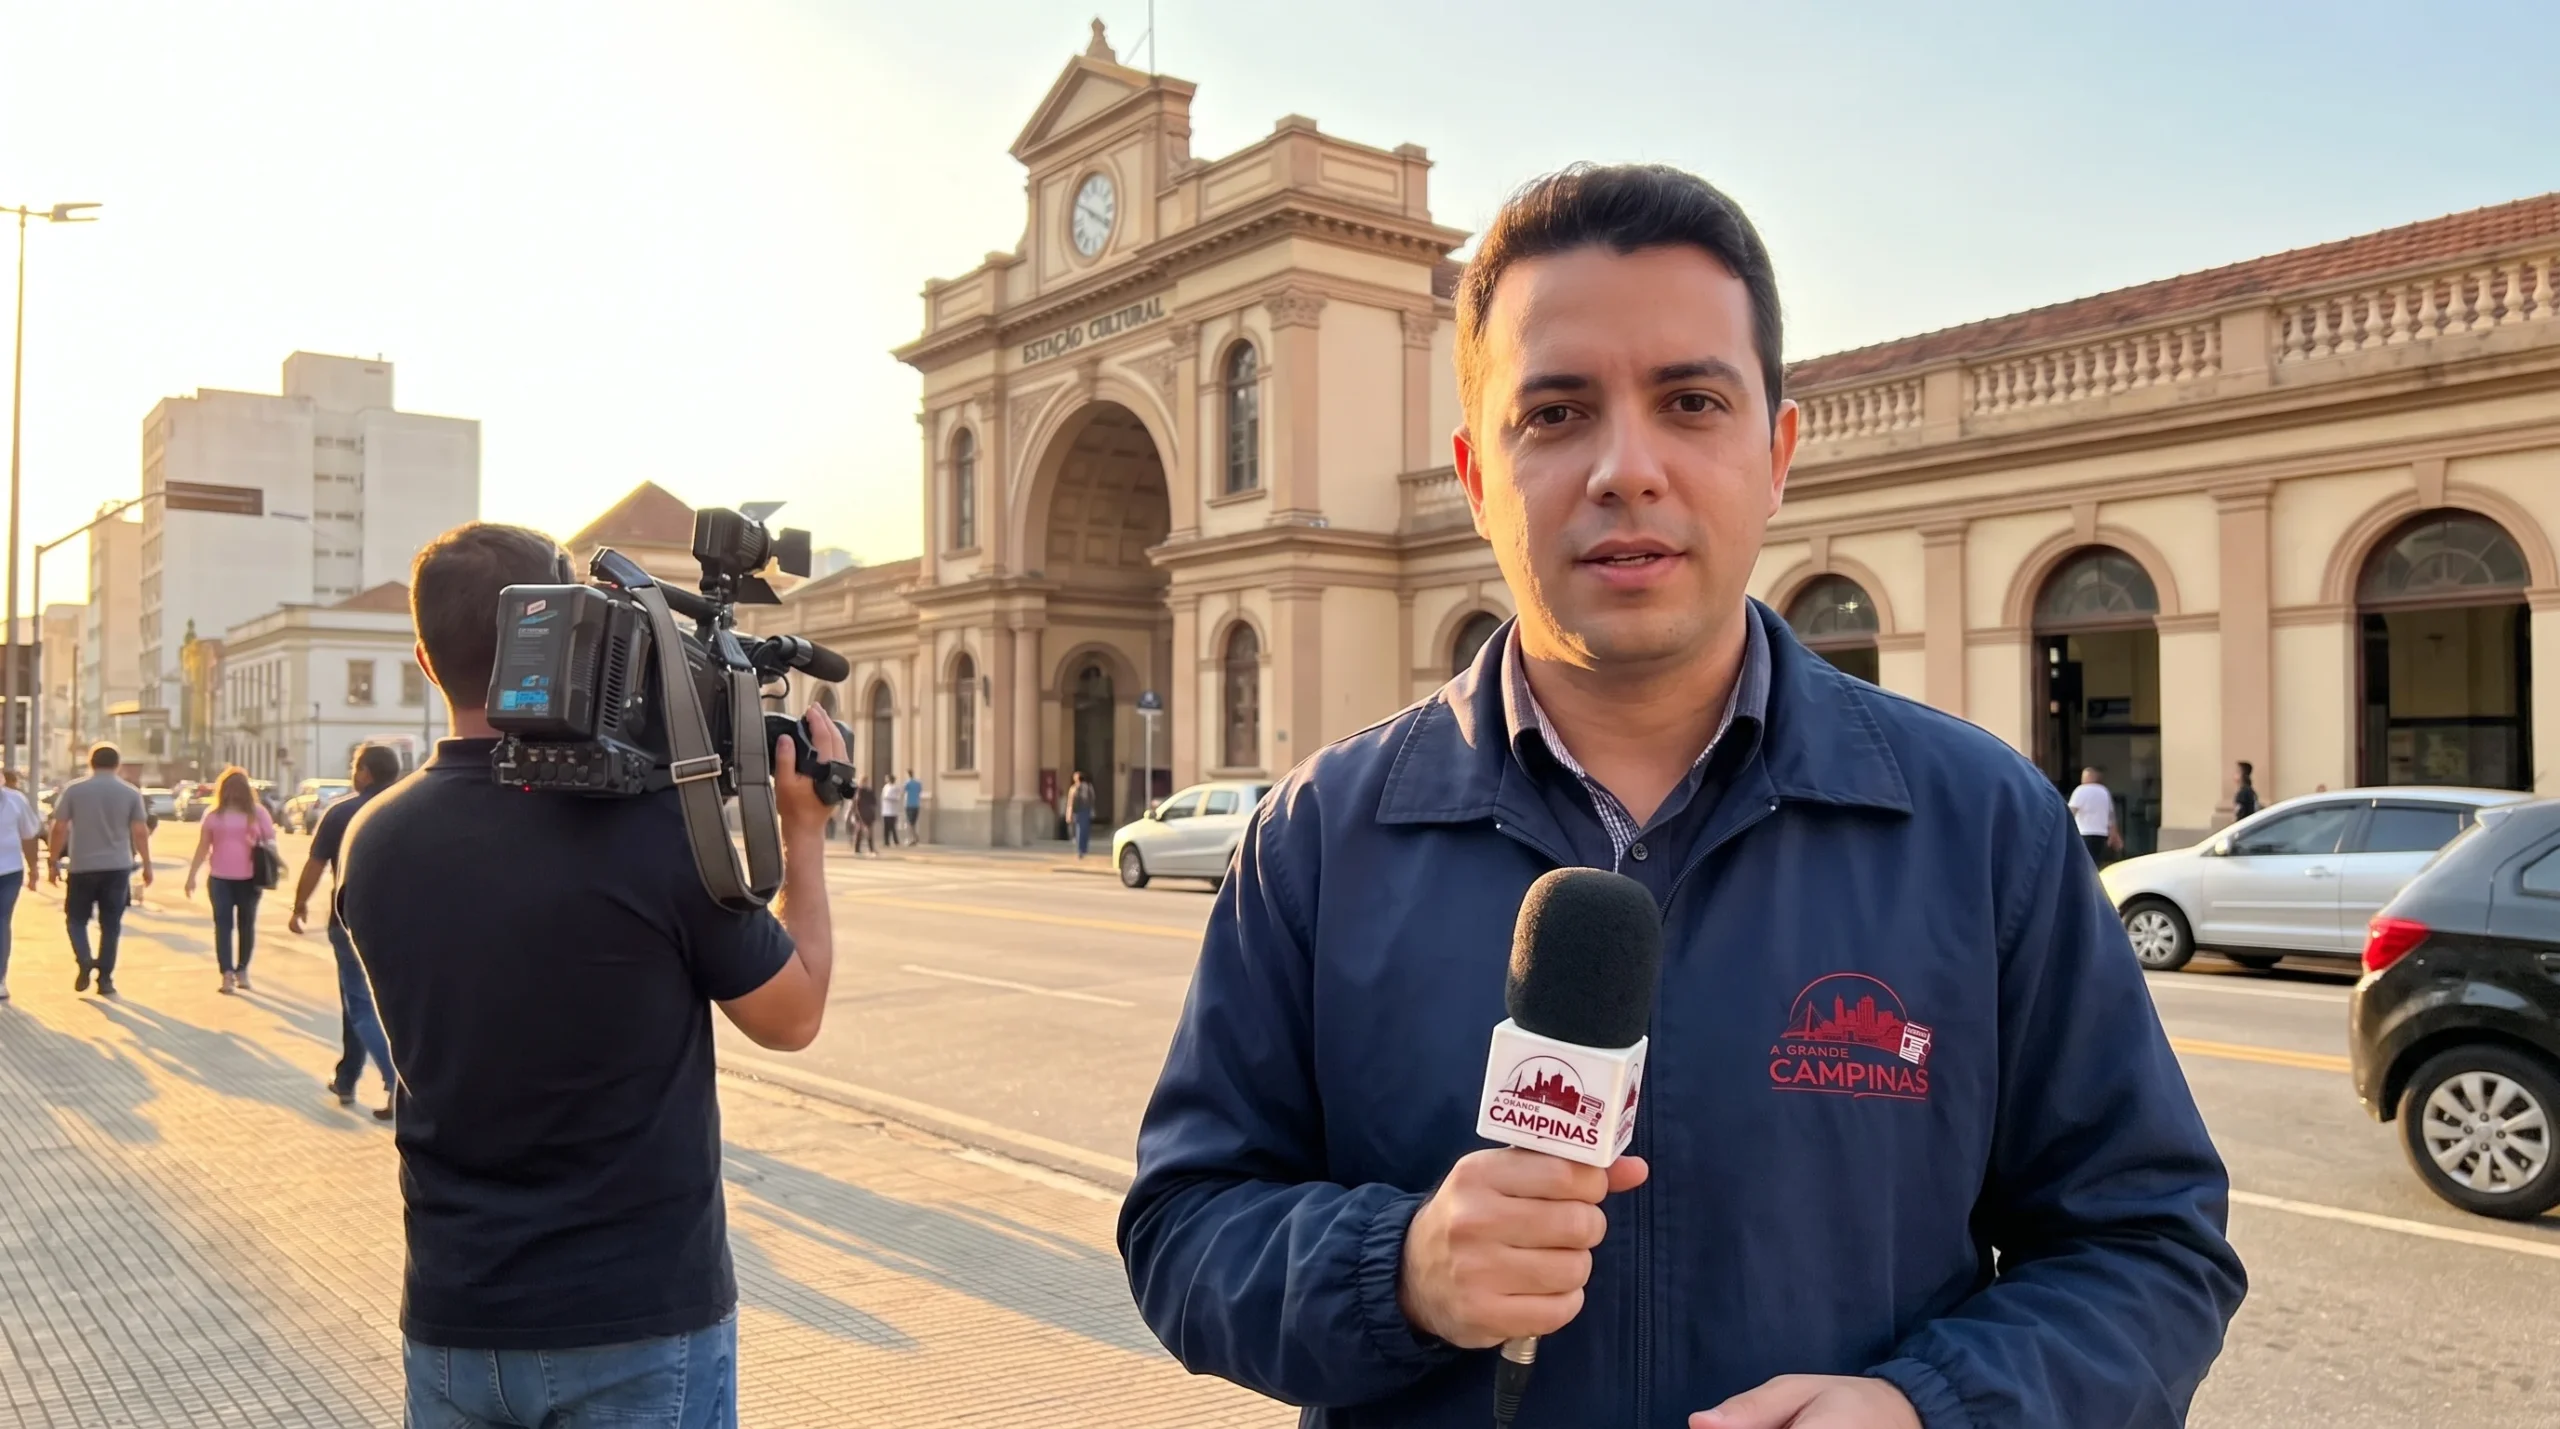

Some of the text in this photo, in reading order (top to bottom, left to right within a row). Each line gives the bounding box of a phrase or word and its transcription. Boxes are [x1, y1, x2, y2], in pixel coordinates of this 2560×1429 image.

[1088, 296, 1165, 340] CULTURAL
[1770, 1045, 1849, 1058] A GRANDE
[1770, 1058, 1928, 1094] CAMPINAS
[1489, 1105, 1599, 1145] CAMPINAS
